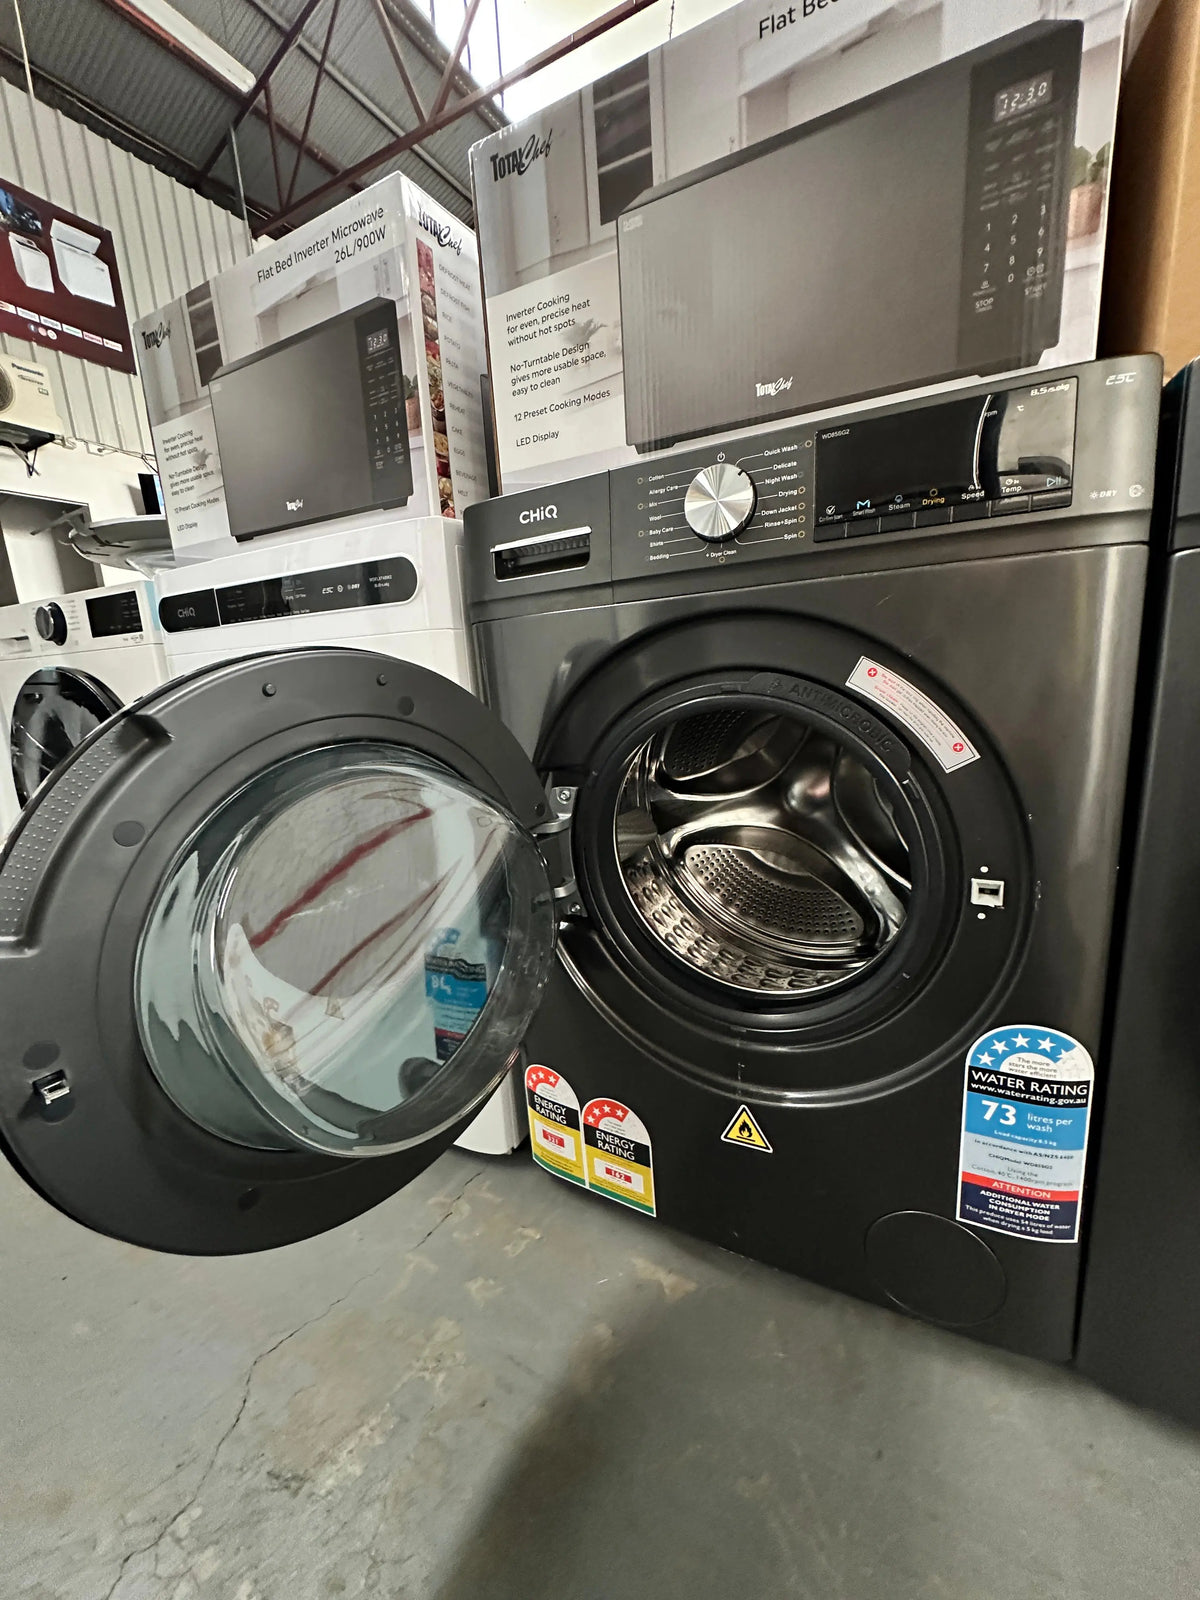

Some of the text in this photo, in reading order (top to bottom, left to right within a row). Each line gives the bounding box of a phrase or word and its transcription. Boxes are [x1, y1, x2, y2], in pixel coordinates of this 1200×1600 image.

[760, 7, 796, 40] Flat
[1012, 214, 1018, 224] 2
[257, 207, 384, 283] Flat Bed Inverter Microwave
[334, 225, 386, 263] 26L/900W
[984, 243, 990, 252] 4
[1010, 235, 1016, 245] 5
[984, 247, 1044, 273] 7 8 9
[1008, 274, 1014, 282] 0
[506, 294, 570, 322] Inverter Cooking
[976, 298, 994, 308] STOP
[507, 299, 590, 334] for even, precise heat
[508, 318, 576, 346] without hot spots
[510, 342, 590, 373] No-Turntable Design
[511, 350, 606, 386] gives more usable space,
[512, 376, 560, 397] easy to clean
[514, 388, 610, 422] 12 Preset Cooking Modes
[516, 429, 560, 447] LED Display
[764, 444, 798, 456] Quick Wash
[773, 460, 797, 470] Delicate
[648, 474, 664, 482] Cotton
[764, 474, 798, 485] Night Wash
[649, 487, 666, 496] Allergy
[778, 489, 798, 497] Drying
[961, 490, 985, 500] Speed
[1002, 485, 1022, 494] Temp
[888, 502, 910, 511] Steam
[922, 496, 945, 506] Drying
[519, 504, 558, 524] CHiQ
[778, 505, 797, 514] Jacket
[764, 518, 798, 528] Rinse+Spin
[650, 552, 670, 560] Bedding
[1018, 1056, 1032, 1065] The
[1030, 1070, 1057, 1079] efficient
[972, 1070, 1088, 1096] WATER RATING
[970, 1082, 1086, 1105] www.waterrating.gov.au
[534, 1094, 566, 1116] ENERGY
[982, 1100, 1016, 1126] 73
[536, 1104, 566, 1125] RATING
[1028, 1112, 1072, 1130] litres per
[1026, 1123, 1052, 1132] wash
[596, 1130, 635, 1151] ENERGY
[994, 1130, 1010, 1138] Load
[1011, 1133, 1038, 1144] capacity
[598, 1140, 635, 1160] RATING
[982, 1141, 1017, 1152] accordance
[1008, 1167, 1026, 1176] Using
[992, 1181, 1050, 1198] ATTENTION
[980, 1190, 1032, 1207] ADDITIONAL
[988, 1198, 1050, 1214] CONSUMPTION
[966, 1204, 978, 1212] This
[998, 1206, 1024, 1218] DRYER
[1026, 1214, 1050, 1222] MODE
[1000, 1220, 1020, 1230] drying
